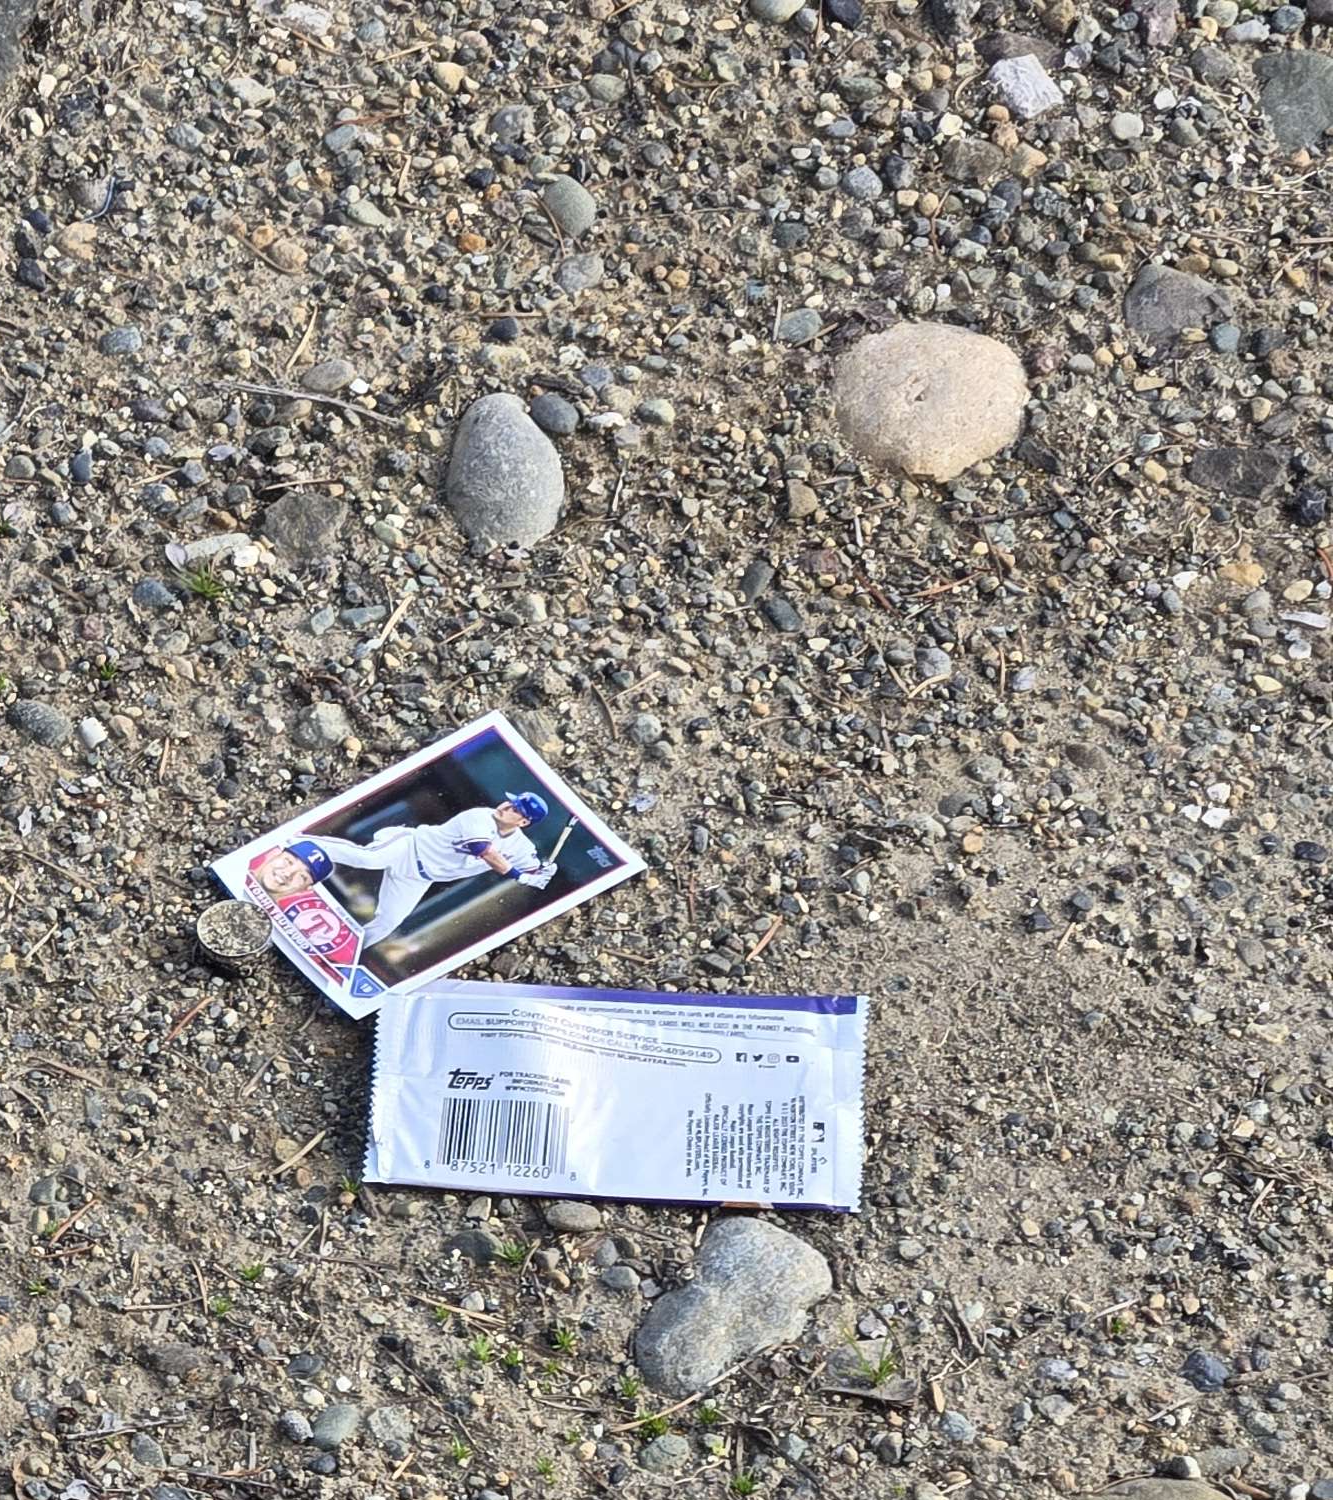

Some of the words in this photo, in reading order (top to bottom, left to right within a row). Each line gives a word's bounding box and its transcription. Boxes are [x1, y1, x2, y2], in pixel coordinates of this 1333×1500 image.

[423, 1159, 431, 1169] 8
[450, 1160, 496, 1175] 87521
[506, 1164, 551, 1180] 12260
